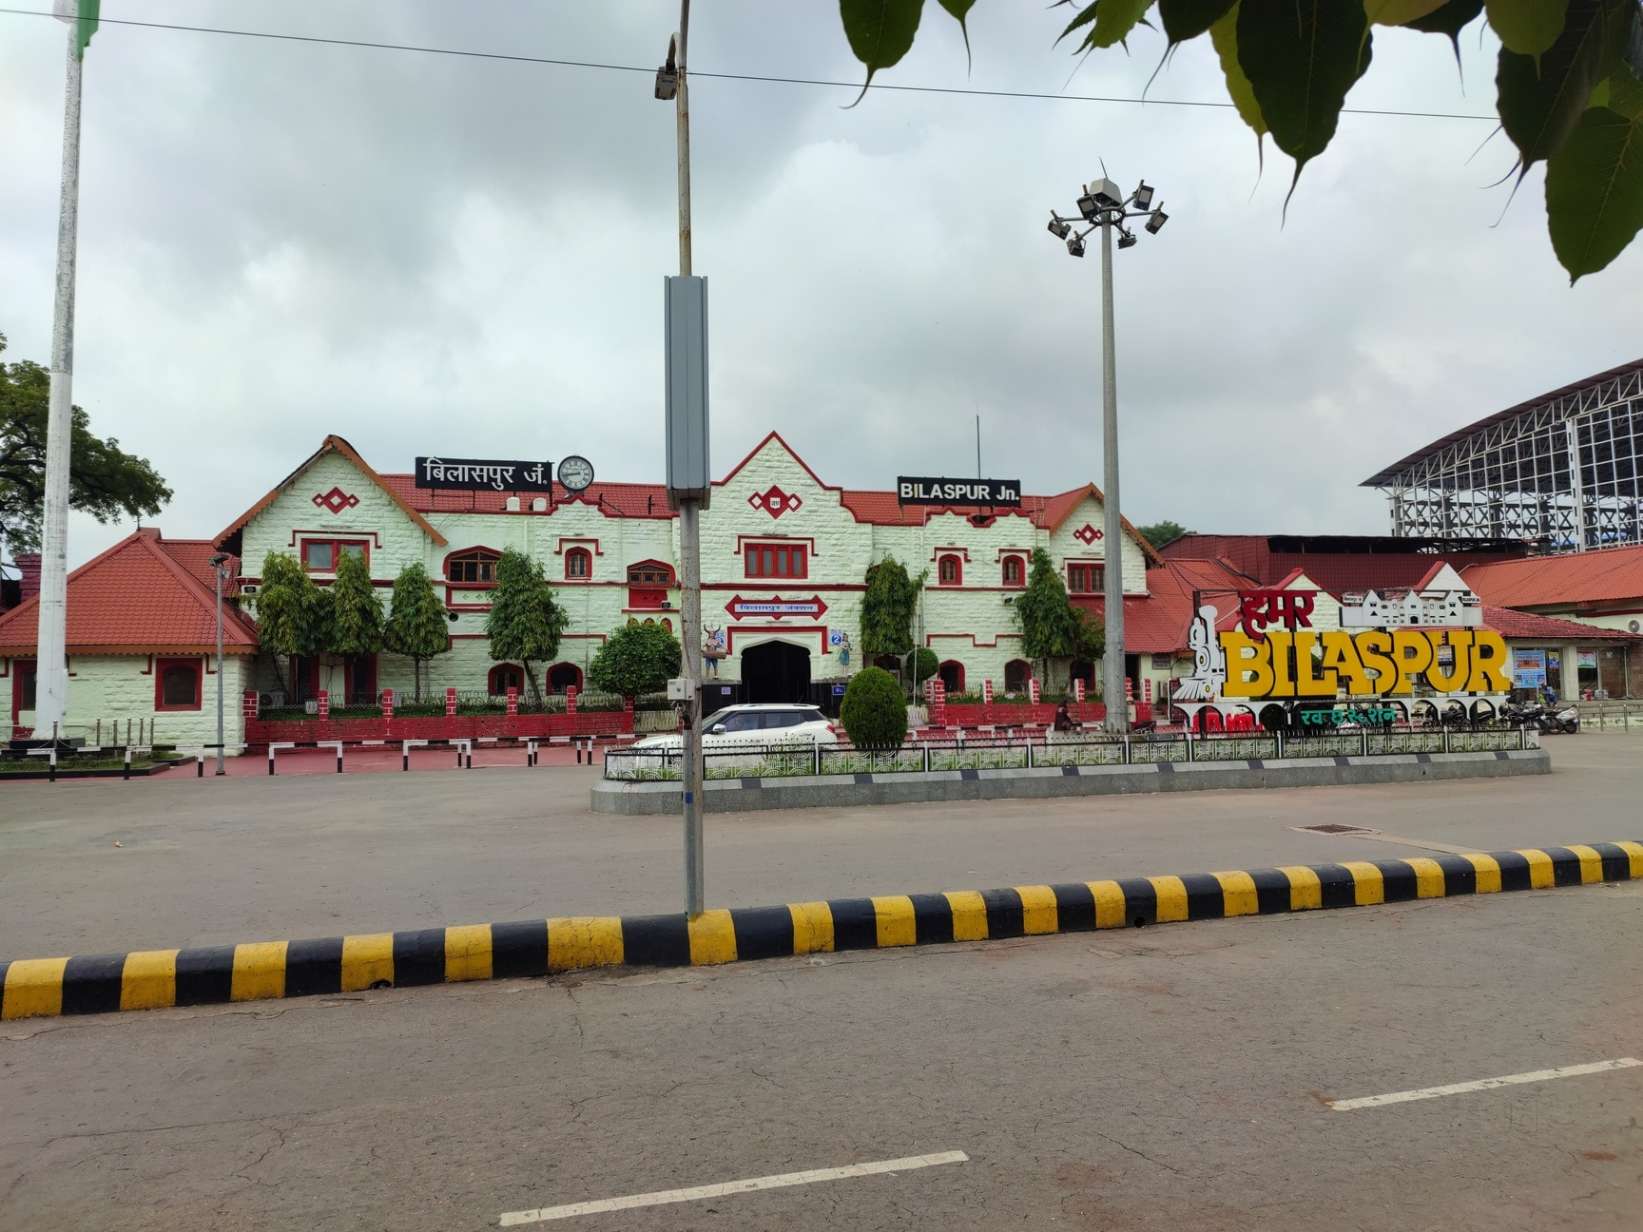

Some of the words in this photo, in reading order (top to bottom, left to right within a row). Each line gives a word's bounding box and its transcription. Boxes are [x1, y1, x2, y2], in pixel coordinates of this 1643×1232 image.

[423, 458, 516, 490] बिलासपुर
[900, 483, 991, 500] BILASPUR
[996, 485, 1020, 500] Jn.
[1237, 590, 1317, 642] हमर
[1219, 631, 1513, 697] BILASPUR
